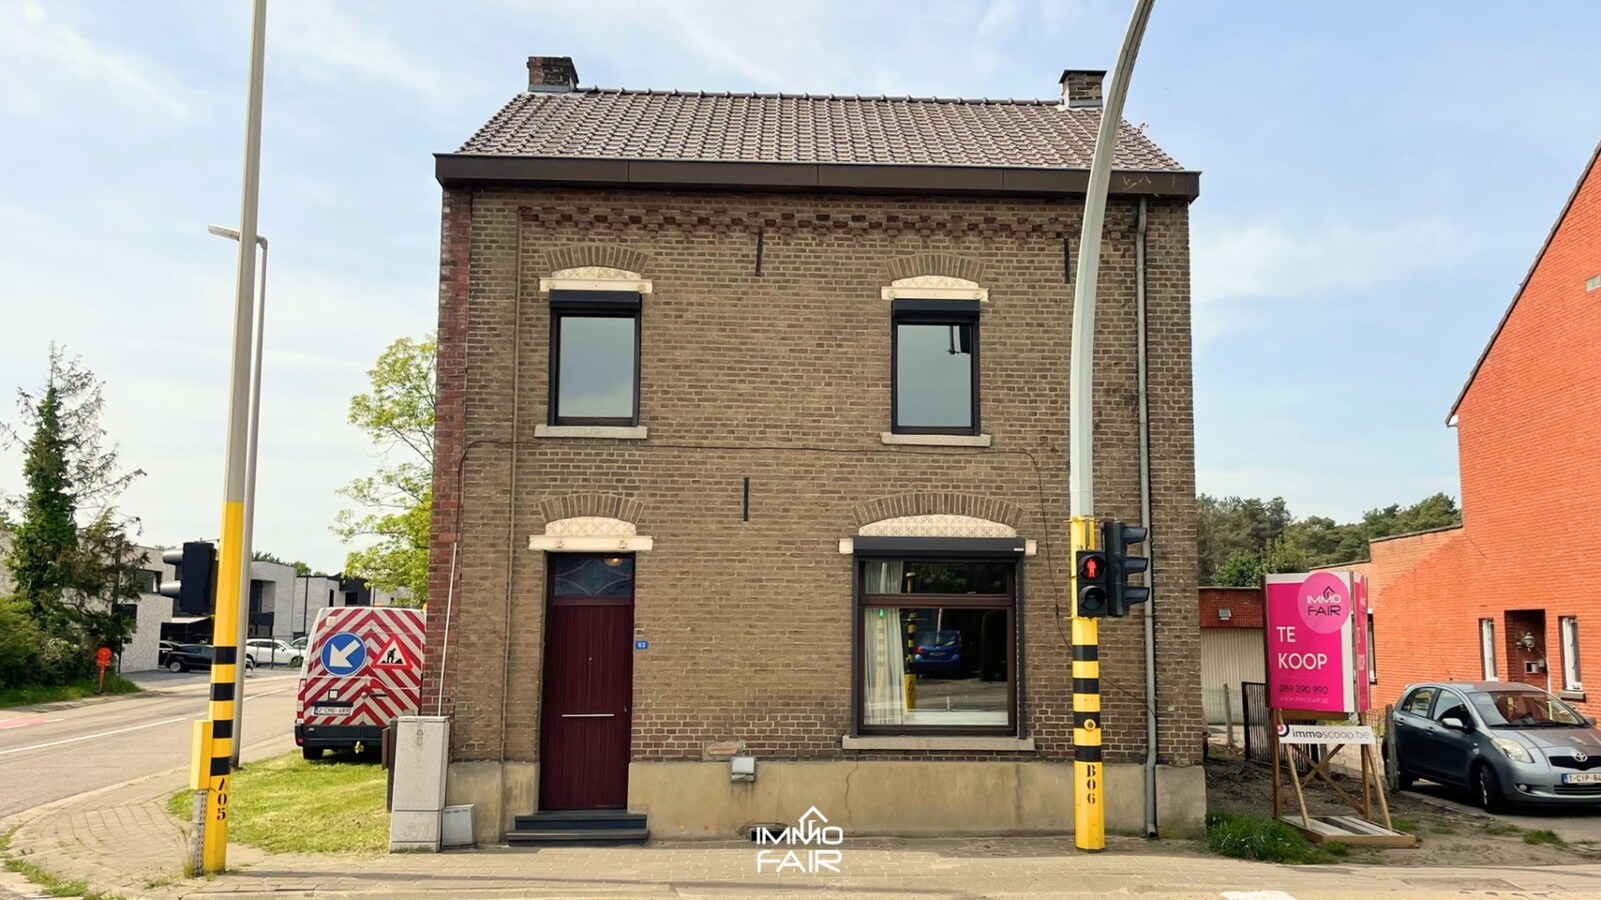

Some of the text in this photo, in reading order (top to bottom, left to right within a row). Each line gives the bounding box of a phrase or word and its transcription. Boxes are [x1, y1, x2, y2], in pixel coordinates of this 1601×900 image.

[1306, 595, 1341, 604] IMMO
[1307, 605, 1342, 616] FAIR
[1276, 626, 1296, 643] TE
[1278, 652, 1328, 670] KOOP
[1296, 685, 1310, 693] 390
[1312, 686, 1328, 694] 990
[1292, 728, 1370, 739] immoscoop.be
